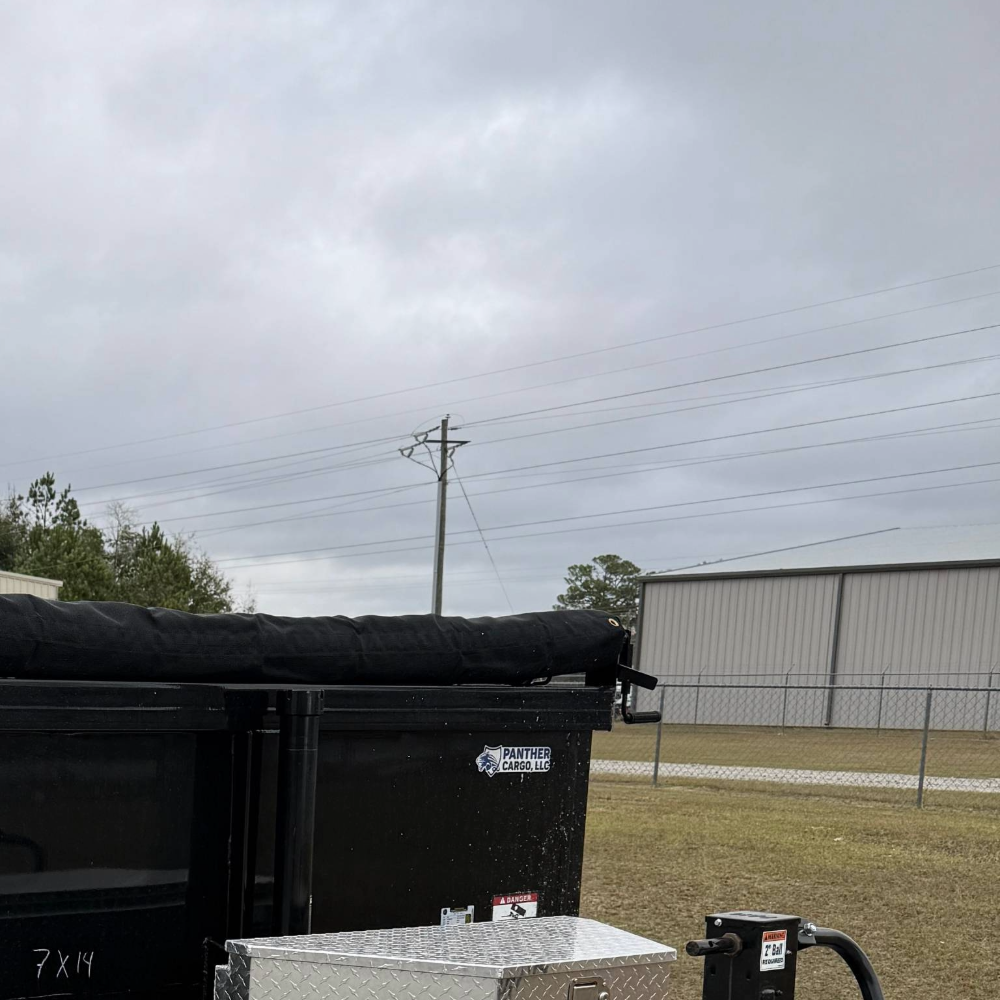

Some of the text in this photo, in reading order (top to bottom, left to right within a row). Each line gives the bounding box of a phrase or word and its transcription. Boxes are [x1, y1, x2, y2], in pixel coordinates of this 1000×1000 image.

[503, 747, 550, 760] PANTHER
[502, 761, 550, 772] CARGO, LLC
[506, 894, 532, 904] DANGER
[772, 943, 783, 956] Ball
